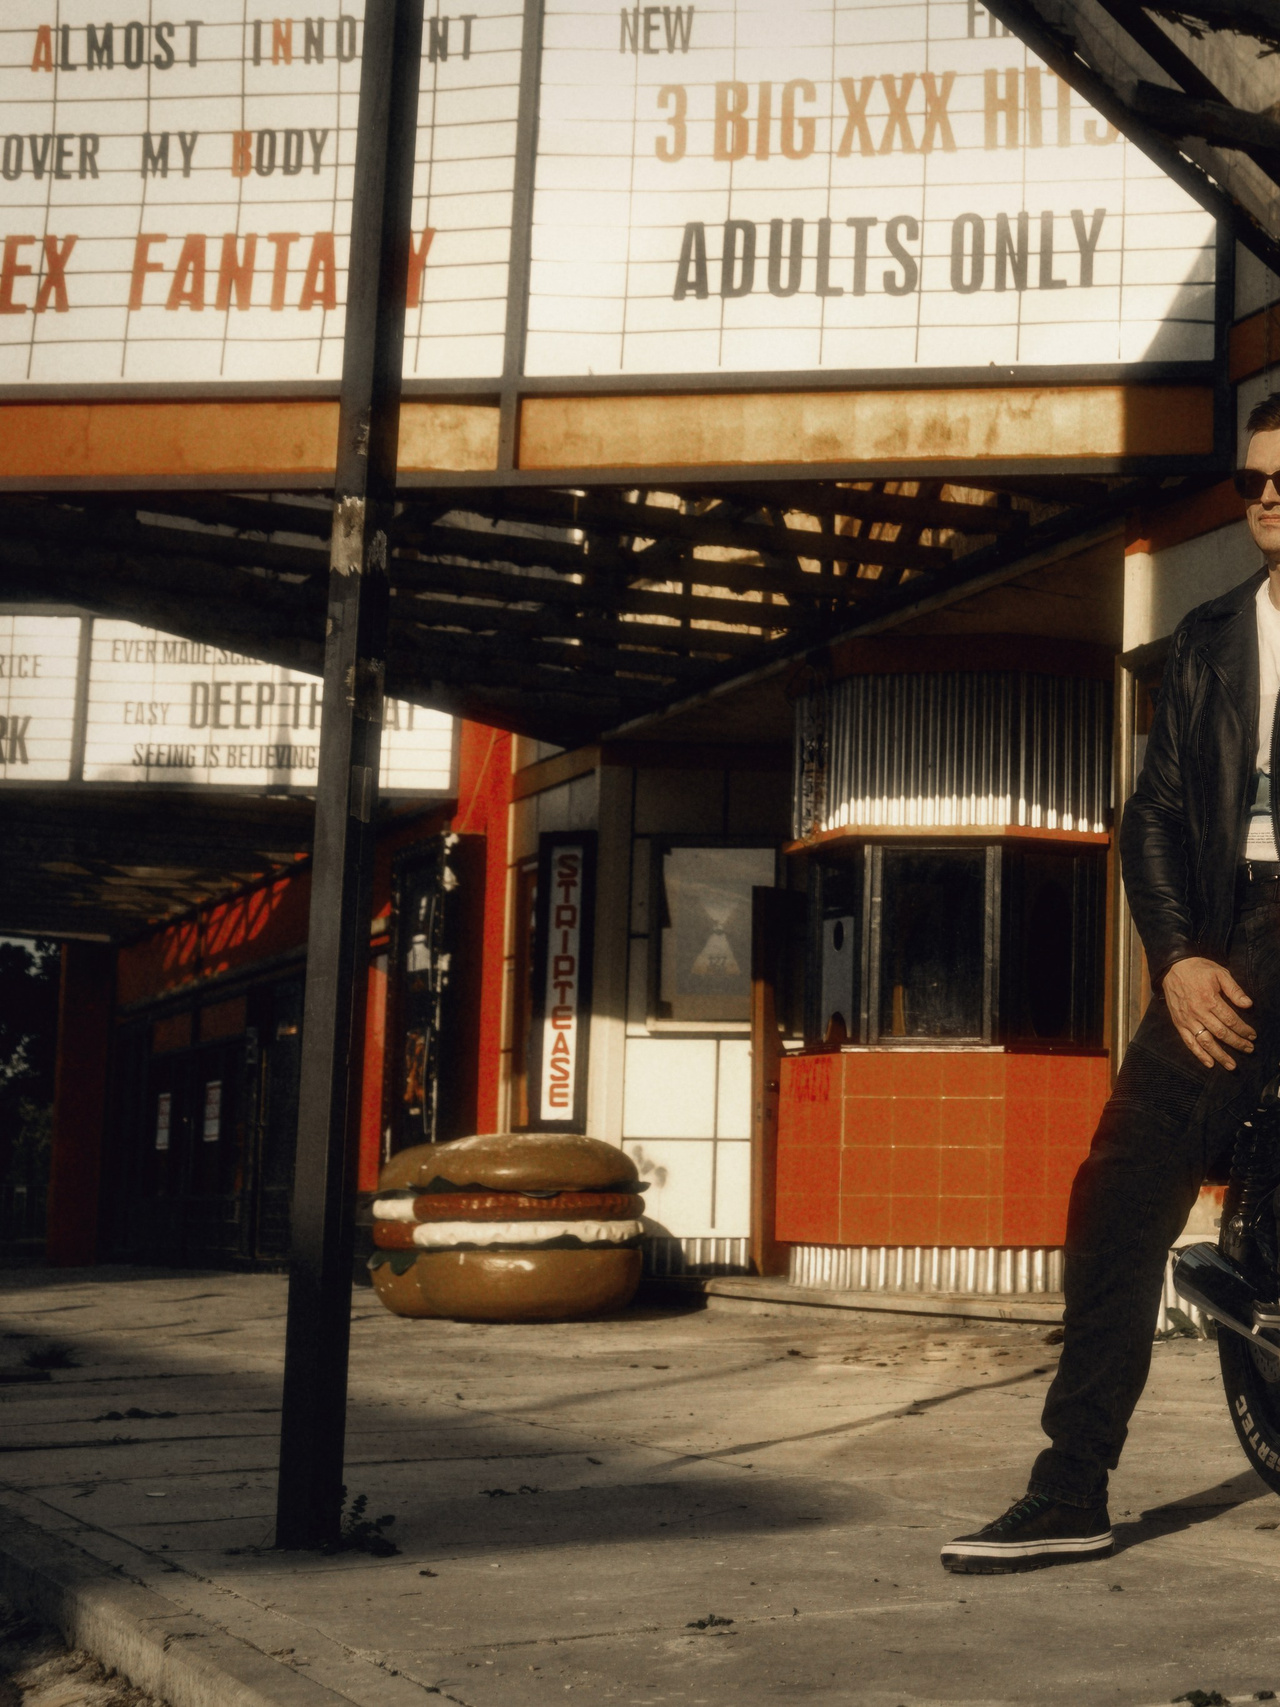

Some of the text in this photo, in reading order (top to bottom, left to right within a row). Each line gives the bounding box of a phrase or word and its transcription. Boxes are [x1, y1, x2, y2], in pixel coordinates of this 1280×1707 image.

[31, 14, 477, 72] ALMOST INNONT
[620, 5, 694, 54] NEW
[655, 84, 687, 163] 3
[713, 79, 817, 162] BIG
[837, 70, 957, 157] XXX
[2, 129, 330, 180] OVER MY BODY
[128, 227, 436, 311] FANTAY
[673, 208, 1107, 301] ADULTS ONLY
[112, 639, 156, 664] EVER
[124, 701, 170, 726] EASY
[190, 682, 275, 730] DEEP
[133, 743, 316, 770] SEEING IS BELIEVING
[549, 854, 579, 1108] STRIPTEASE
